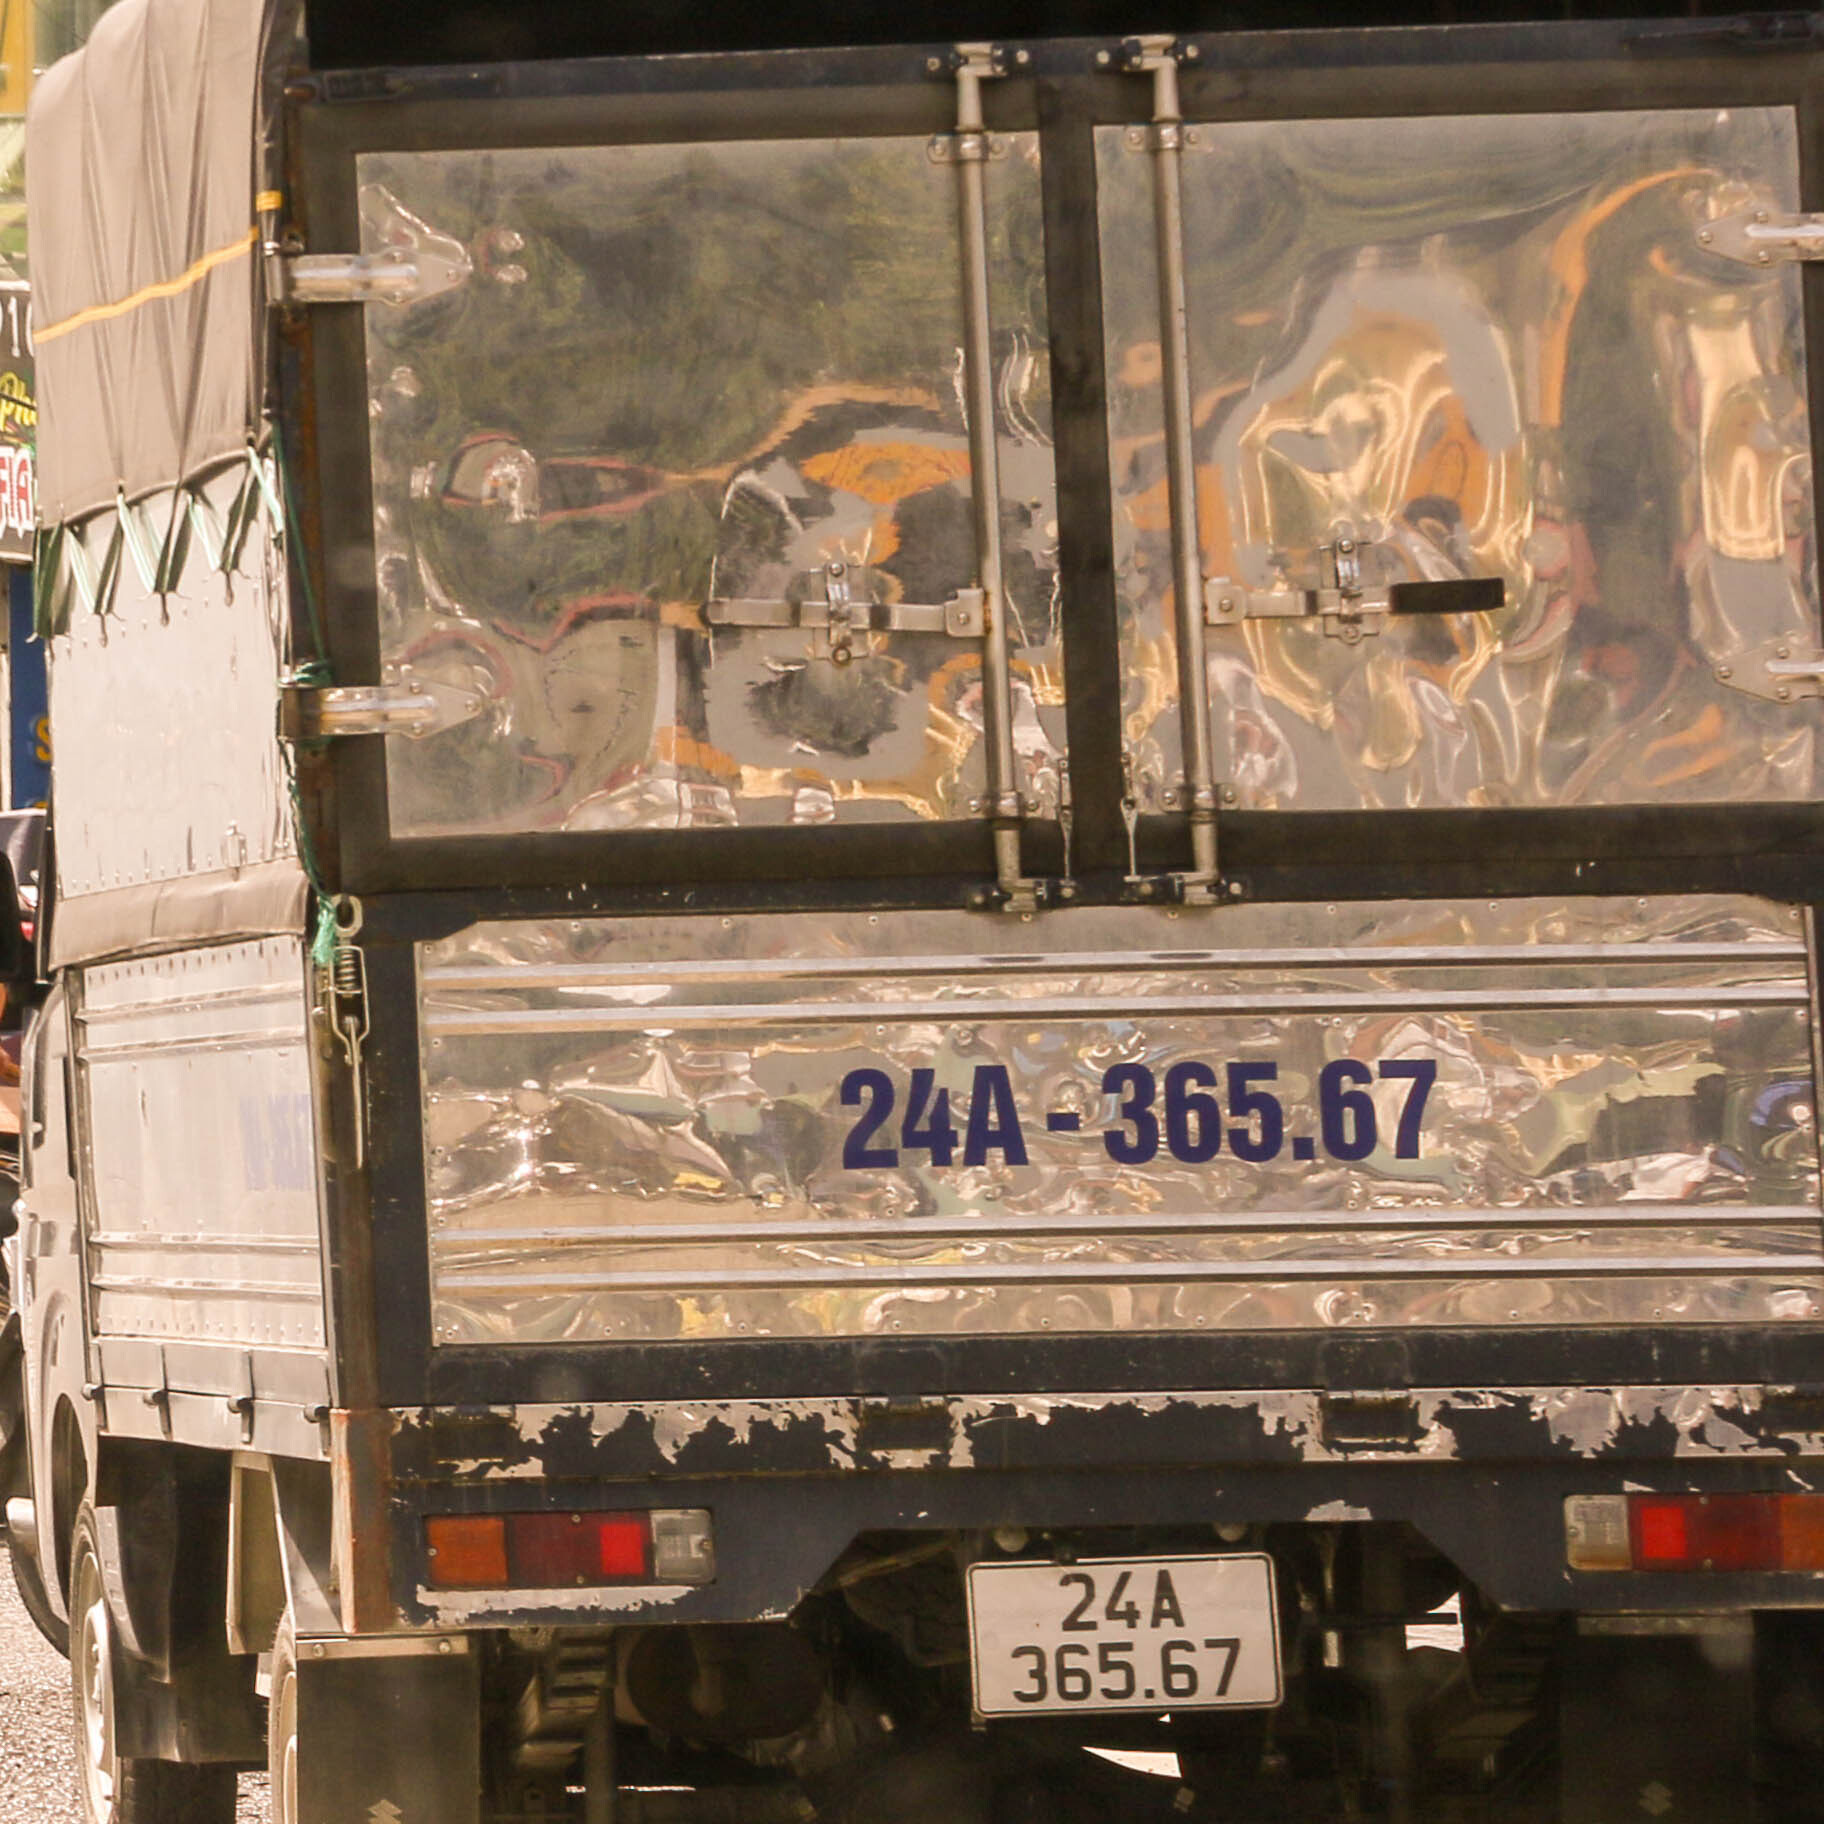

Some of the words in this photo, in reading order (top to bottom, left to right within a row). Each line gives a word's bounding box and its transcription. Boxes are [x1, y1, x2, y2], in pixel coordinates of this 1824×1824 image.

[7, 295, 21, 358] 1
[840, 1064, 1028, 1170] 24A
[1103, 1058, 1439, 1164] 365.67
[1059, 1572, 1184, 1633] 24A
[1011, 1636, 1244, 1703] 365.67
